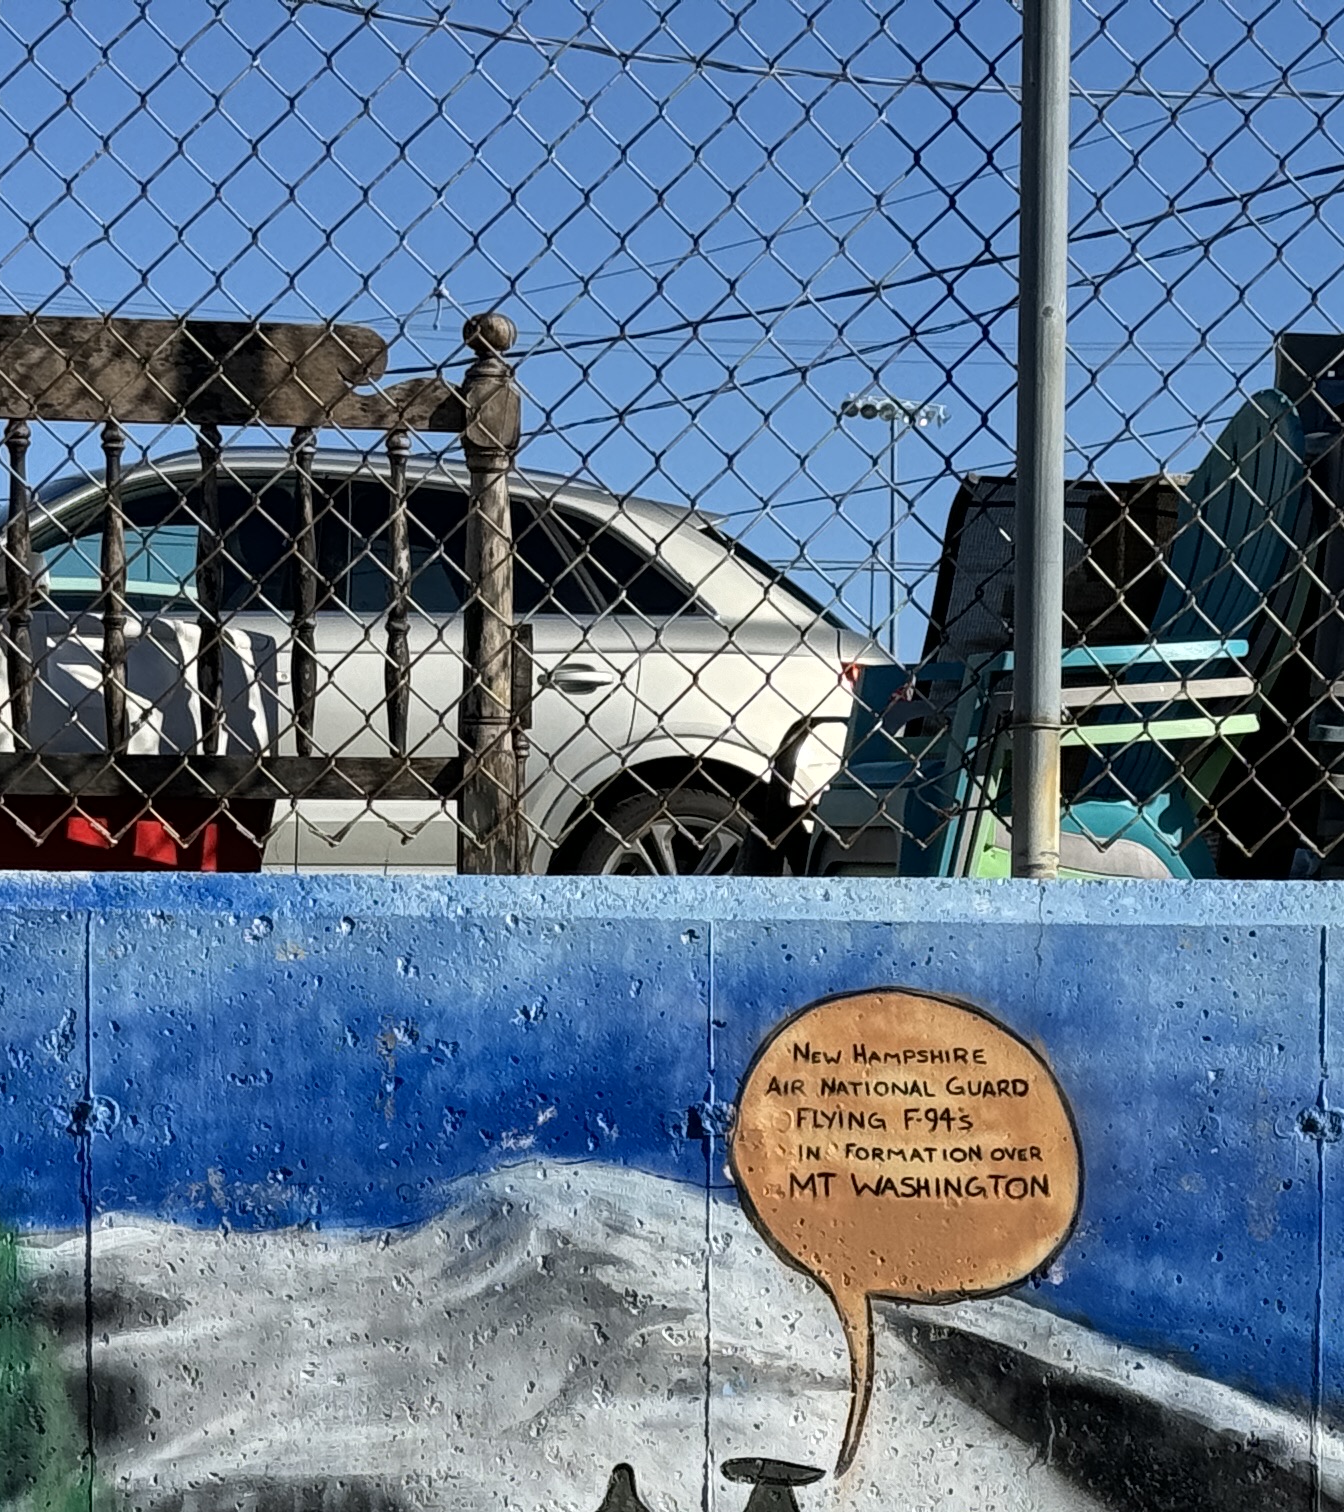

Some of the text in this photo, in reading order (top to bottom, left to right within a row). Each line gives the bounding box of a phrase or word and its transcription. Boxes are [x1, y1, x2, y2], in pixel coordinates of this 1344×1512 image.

[793, 1042, 988, 1065] NEW HAMPSHIRE
[766, 1076, 1029, 1097] AIR NATIONAL GUARD
[797, 1108, 886, 1131] FLYING
[798, 1143, 1043, 1163] IN FORMATION OVER
[790, 1173, 1049, 1198] MT WASHINGTON
